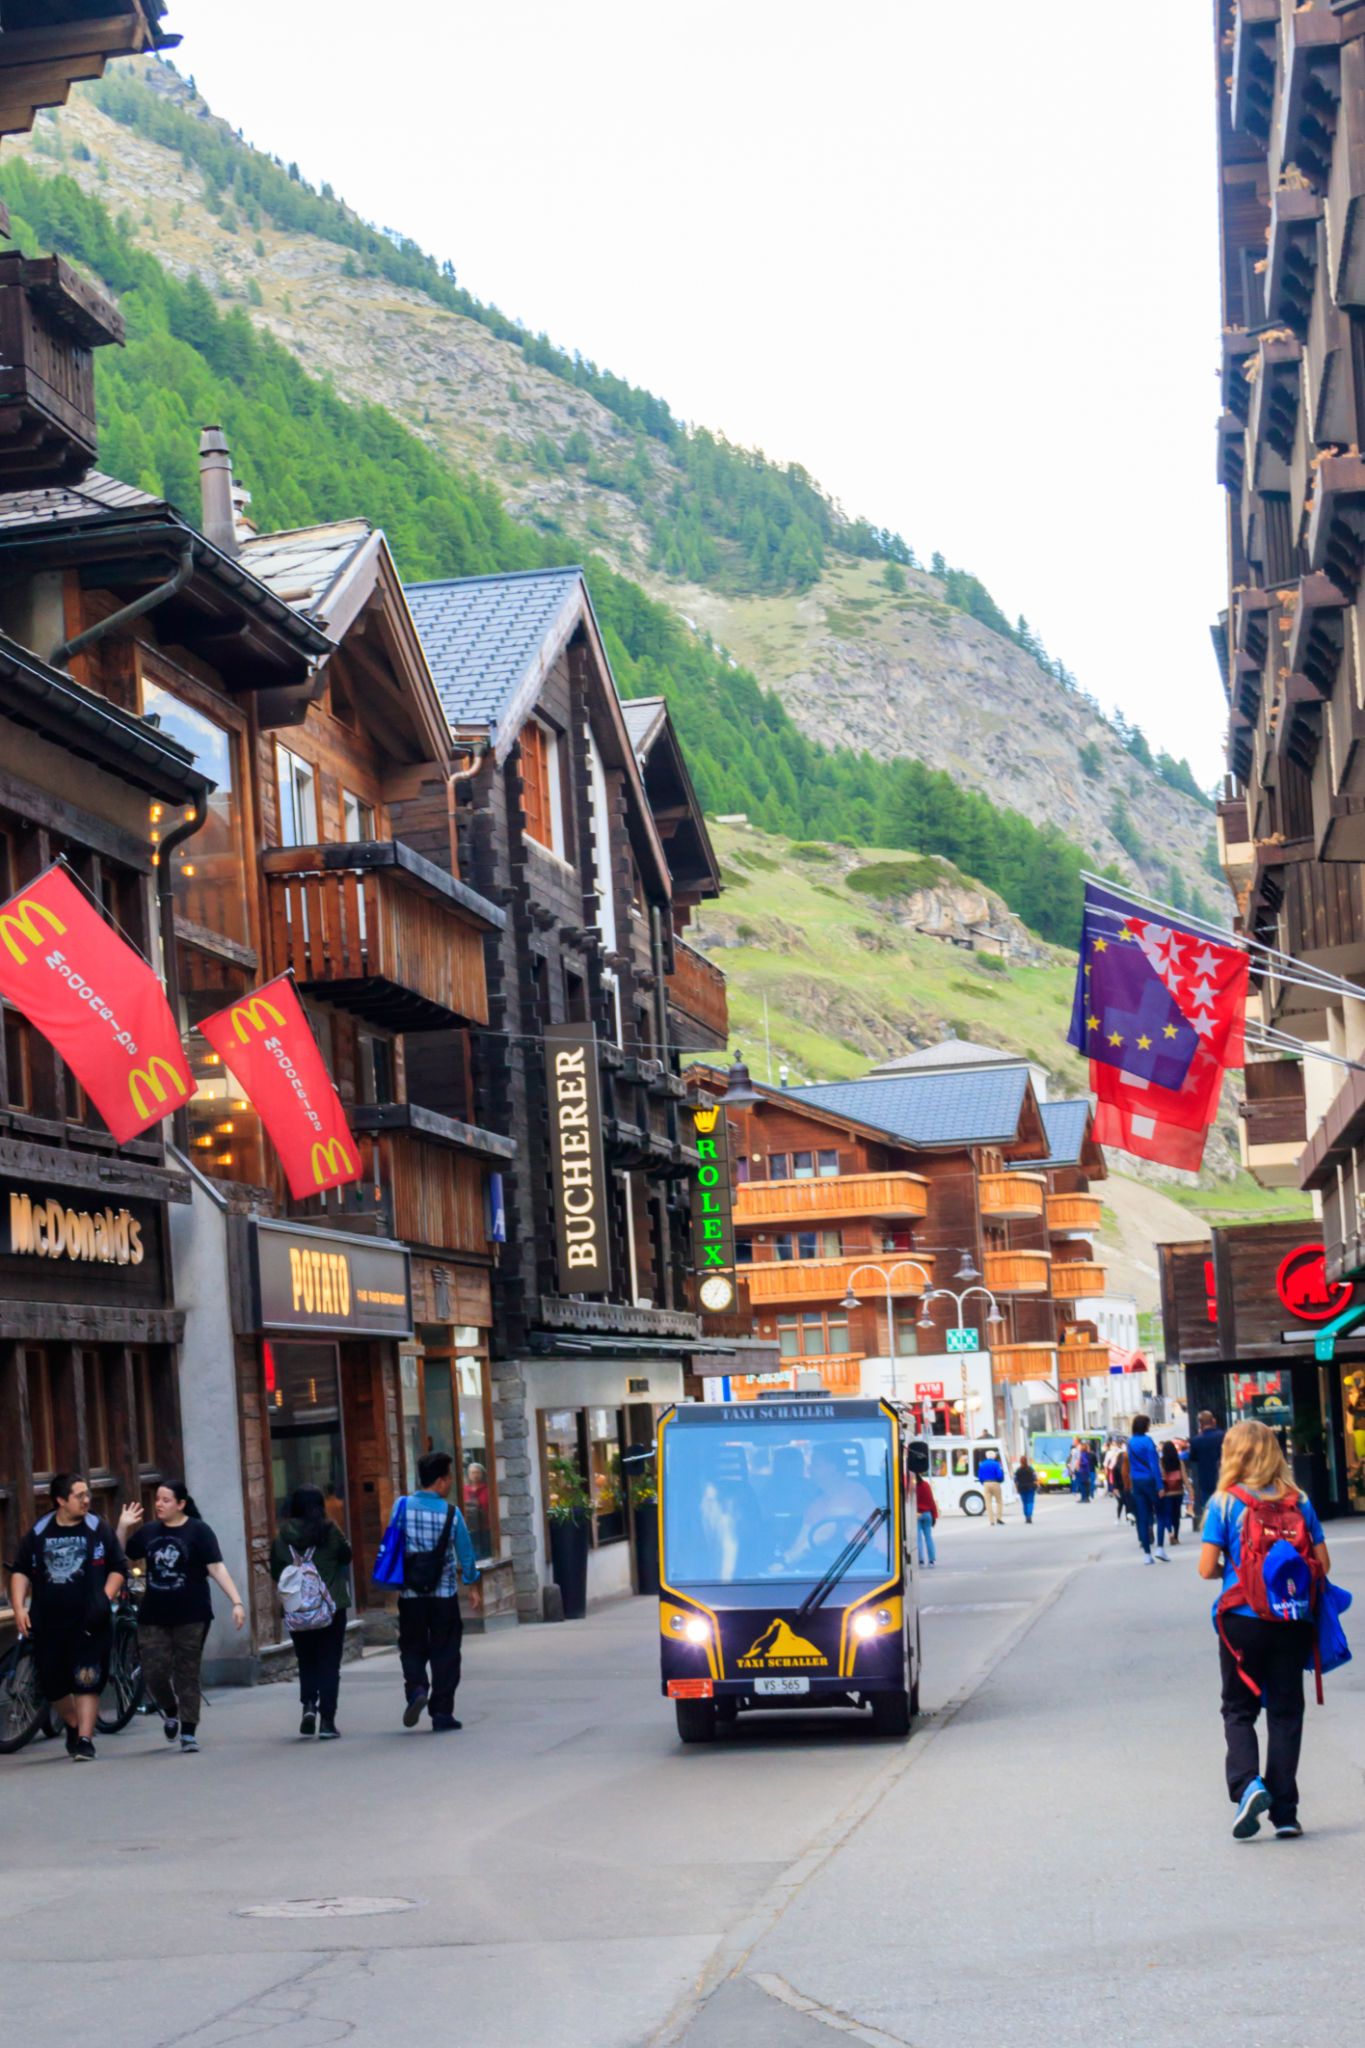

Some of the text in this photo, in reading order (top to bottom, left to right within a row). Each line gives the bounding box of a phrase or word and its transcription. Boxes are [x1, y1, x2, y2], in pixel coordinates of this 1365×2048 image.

[555, 1047, 597, 1268] BUCHERER
[9, 1192, 144, 1265] McDonald's
[695, 1139, 724, 1266] ROLEX
[289, 1247, 350, 1317] POTATO
[720, 1405, 835, 1420] TAXI SCHALLER
[918, 1383, 941, 1393] ATM
[736, 1656, 829, 1669] TAXI SCHALLER
